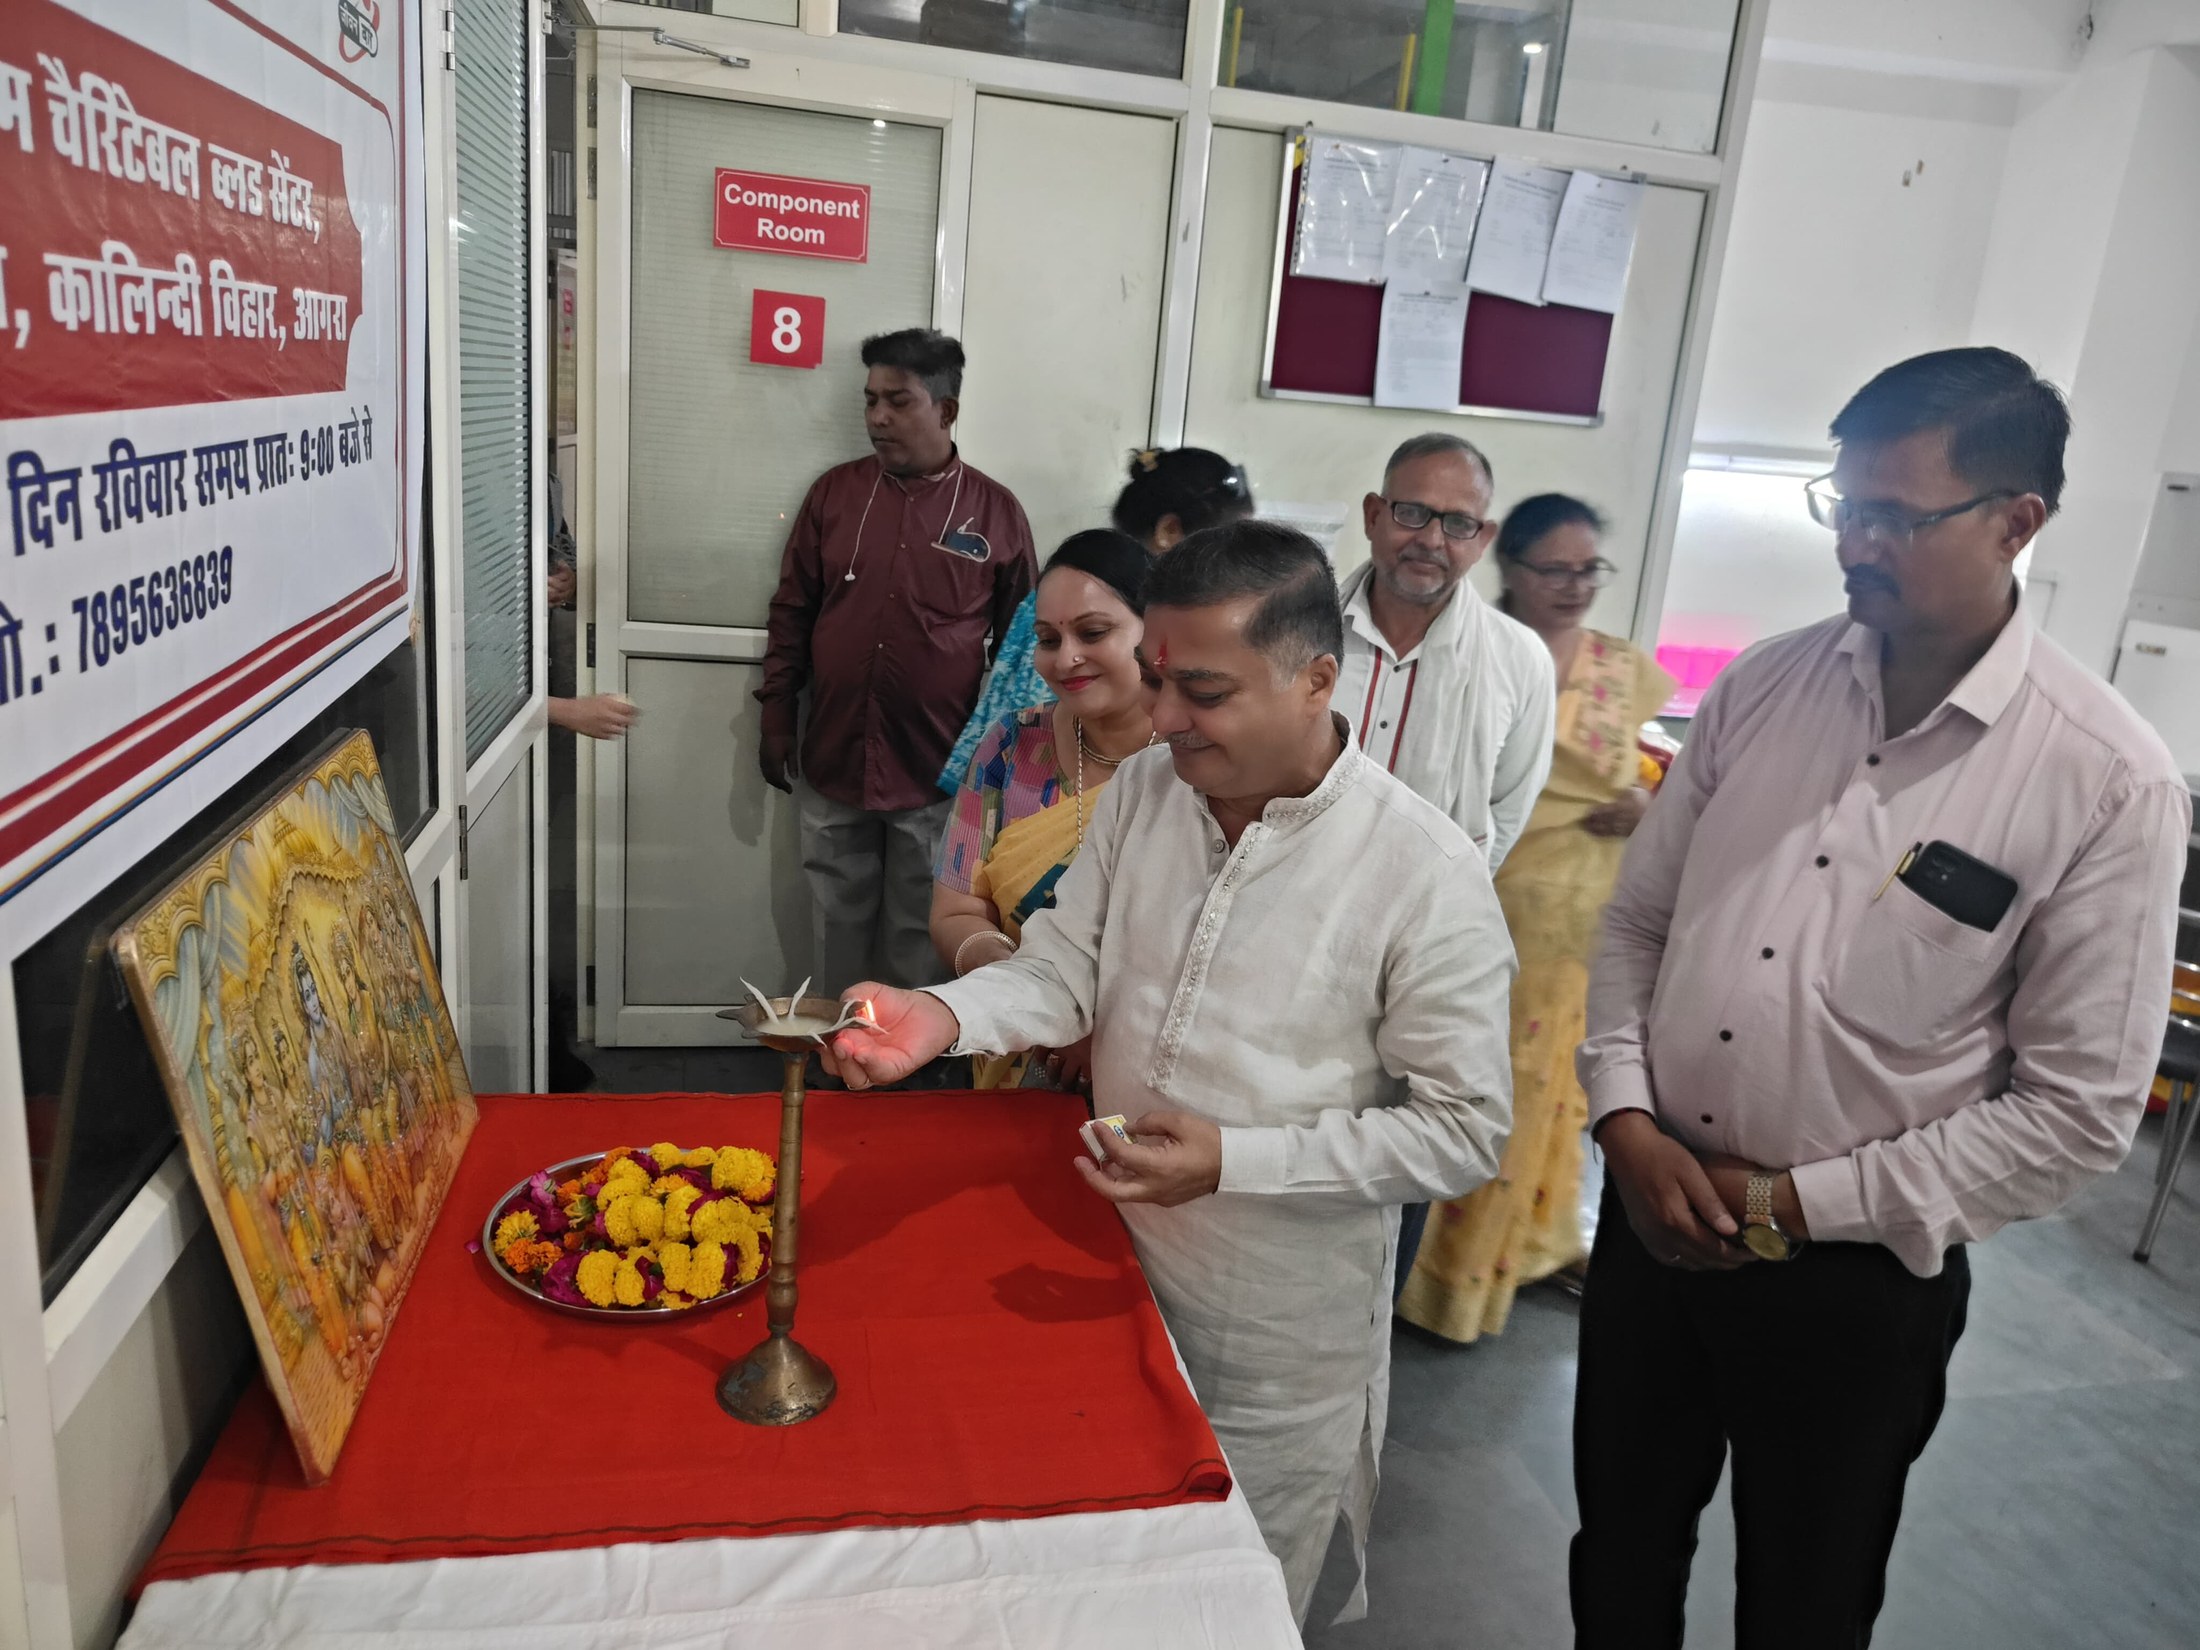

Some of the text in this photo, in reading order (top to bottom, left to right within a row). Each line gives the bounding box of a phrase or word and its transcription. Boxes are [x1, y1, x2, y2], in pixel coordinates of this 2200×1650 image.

[37, 52, 201, 201] चैरिटेबल
[208, 143, 264, 217] ब्लड
[267, 148, 321, 245] सेंटर,
[724, 183, 861, 219] Component
[757, 218, 826, 246] Room
[43, 239, 203, 336] कालिन्दी
[209, 259, 287, 351] विहार,
[292, 287, 348, 341] आगरा
[771, 306, 802, 354] 8
[7, 450, 83, 556] दिन
[91, 437, 187, 533] रविवार
[193, 439, 250, 507] समय
[300, 425, 335, 482] 9:00
[338, 406, 361, 467] बजे
[362, 404, 373, 461] से
[72, 545, 233, 674] 7895636839
